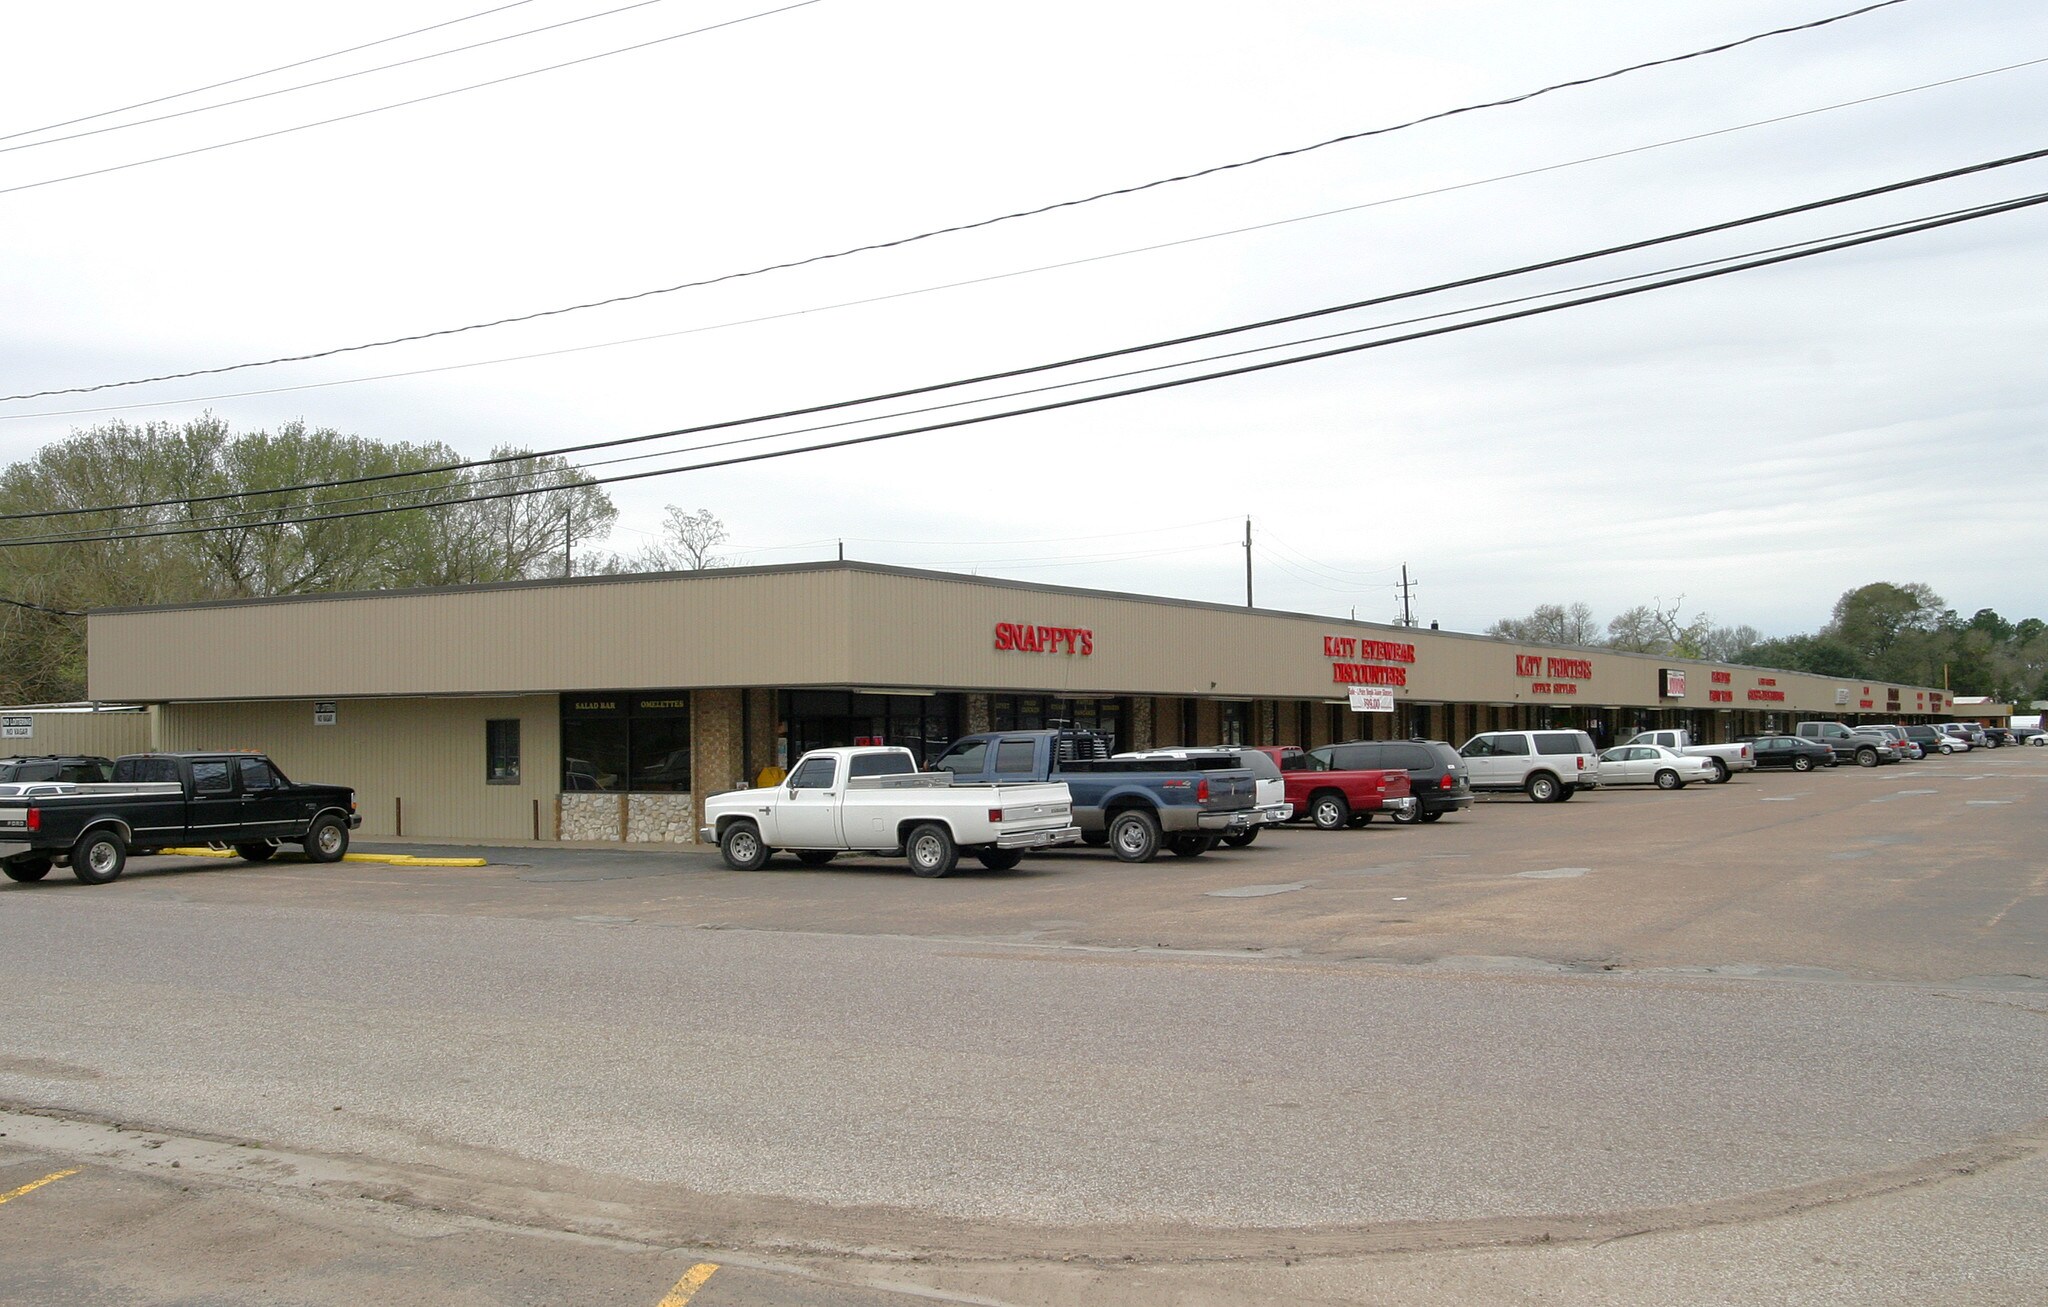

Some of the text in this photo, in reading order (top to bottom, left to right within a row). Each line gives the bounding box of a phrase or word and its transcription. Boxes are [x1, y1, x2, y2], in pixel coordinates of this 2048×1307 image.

[995, 622, 1093, 655] SNAPPY'S
[1324, 636, 1415, 664] KATY EYEWEAR
[1333, 662, 1406, 687] DISCOUNTERS
[1516, 654, 1592, 680] KATY PRINTERS
[575, 702, 616, 710] SALAD BAR
[640, 700, 685, 708] OMELETTES
[6, 728, 28, 736] NO VAGAR
